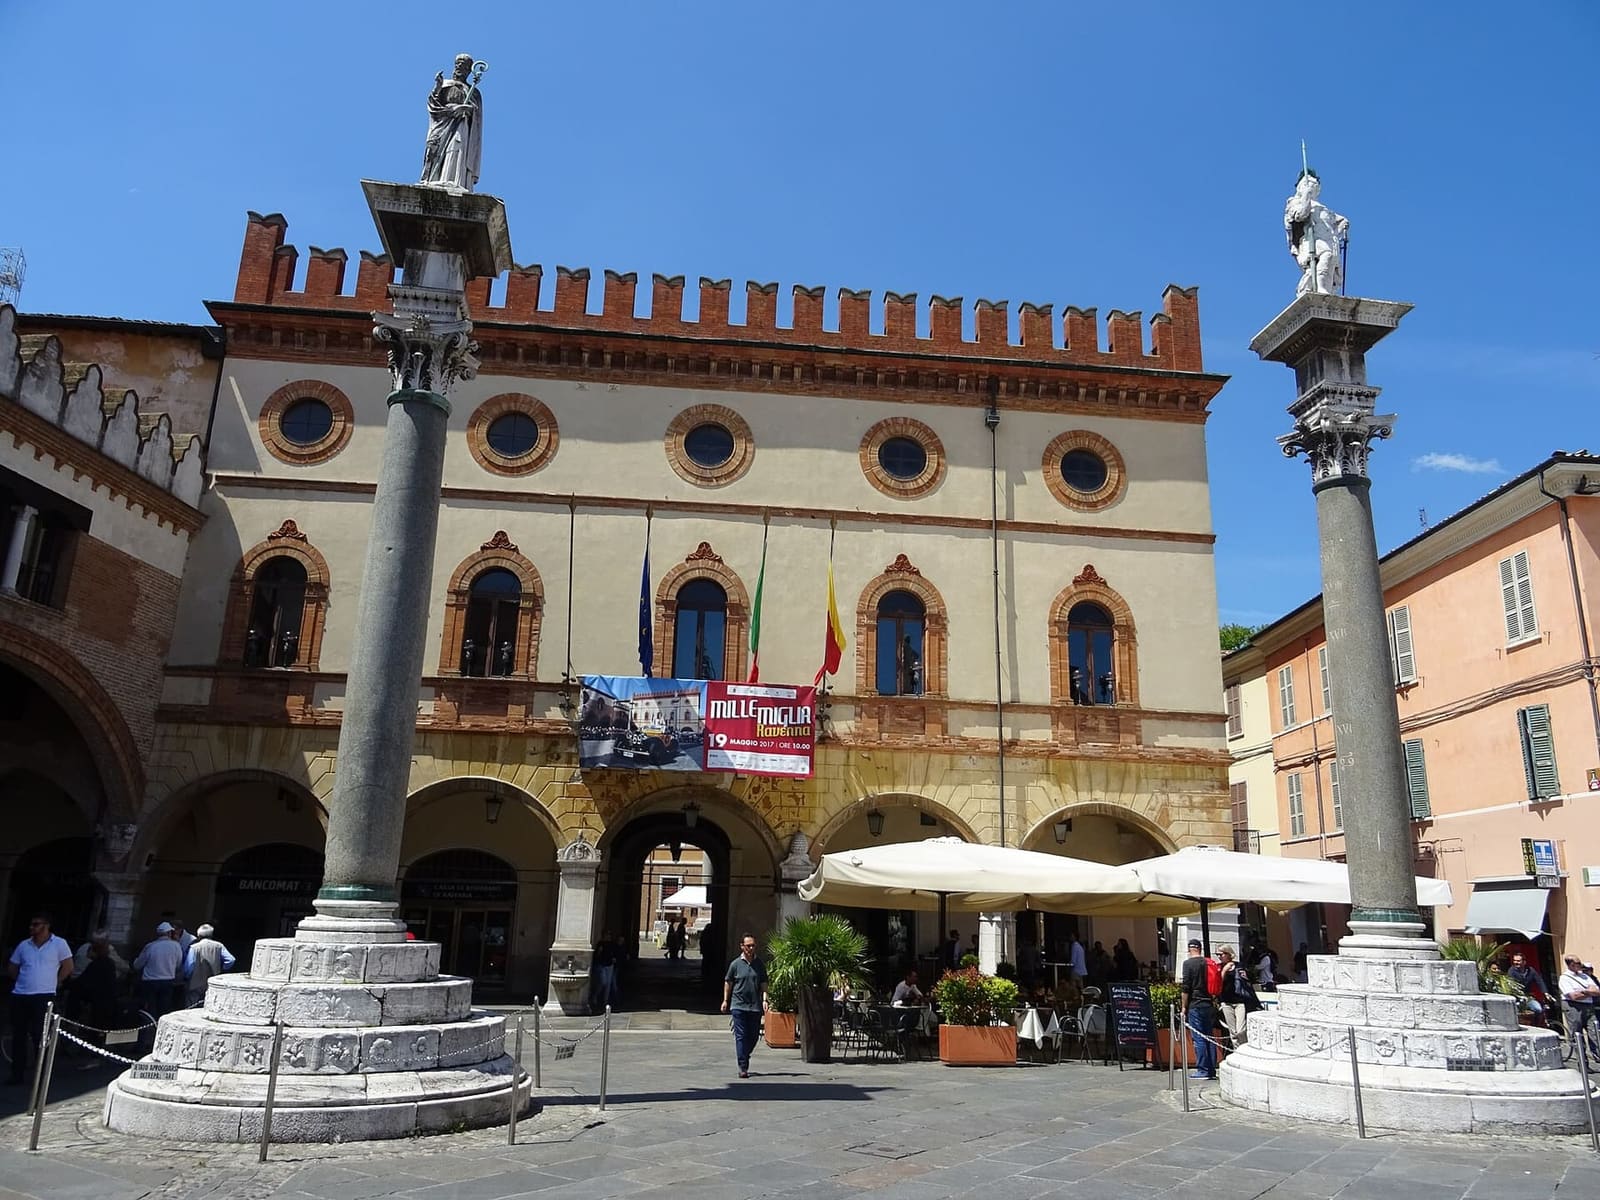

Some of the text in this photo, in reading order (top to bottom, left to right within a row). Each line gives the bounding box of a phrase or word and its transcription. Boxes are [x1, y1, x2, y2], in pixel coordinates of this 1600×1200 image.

[710, 699, 758, 719] MILLE
[757, 706, 811, 726] MIGLIA
[756, 724, 811, 737] Ravenna
[708, 733, 728, 748] 19
[729, 738, 758, 746] MAGGIO
[239, 879, 300, 891] BANCOMAT
